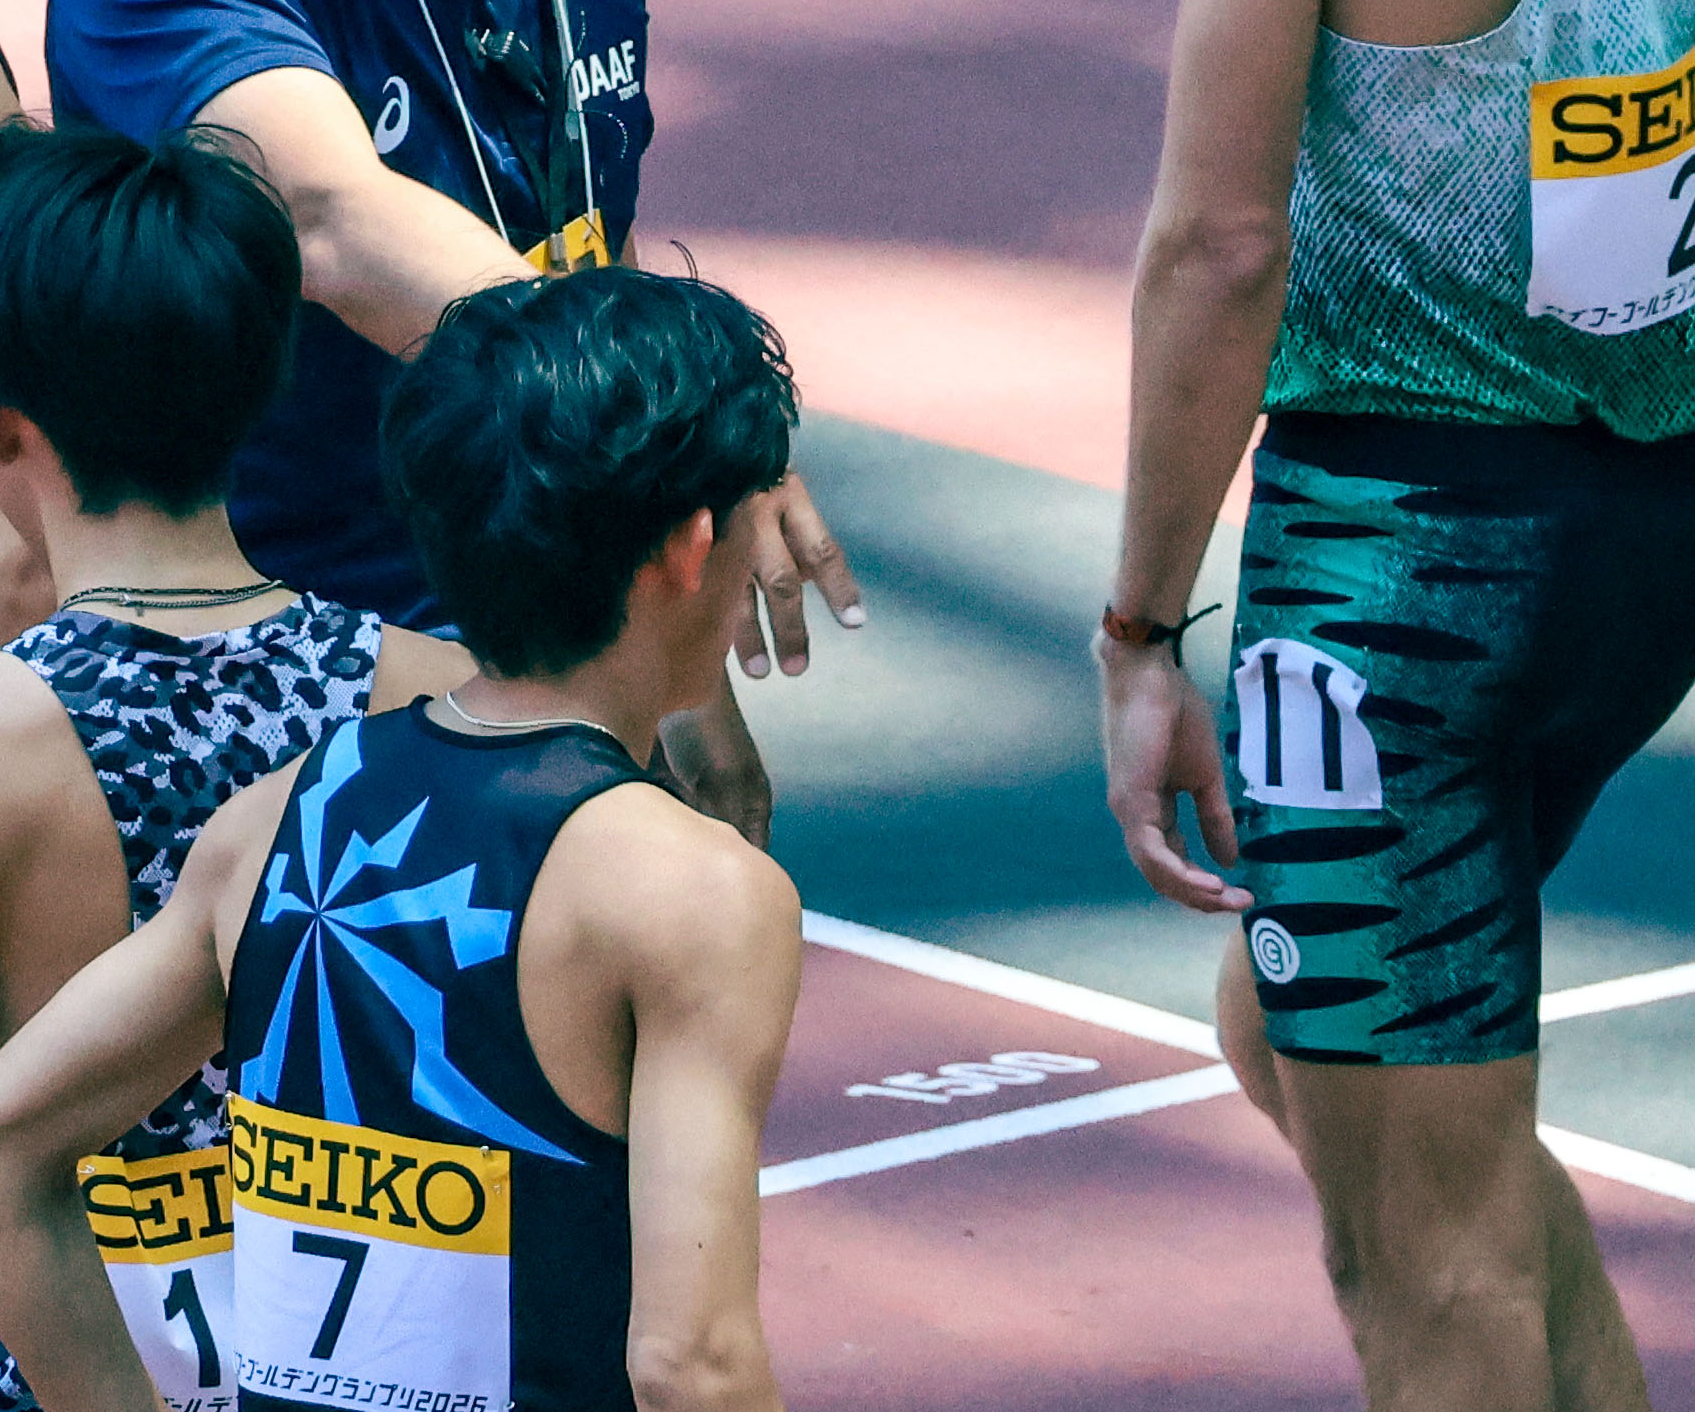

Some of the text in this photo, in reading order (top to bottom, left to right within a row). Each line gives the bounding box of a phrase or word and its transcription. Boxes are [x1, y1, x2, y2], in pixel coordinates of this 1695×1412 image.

[1262, 651, 1344, 792] 11
[231, 1114, 486, 1236] SEIKO
[292, 1231, 370, 1360] 7
